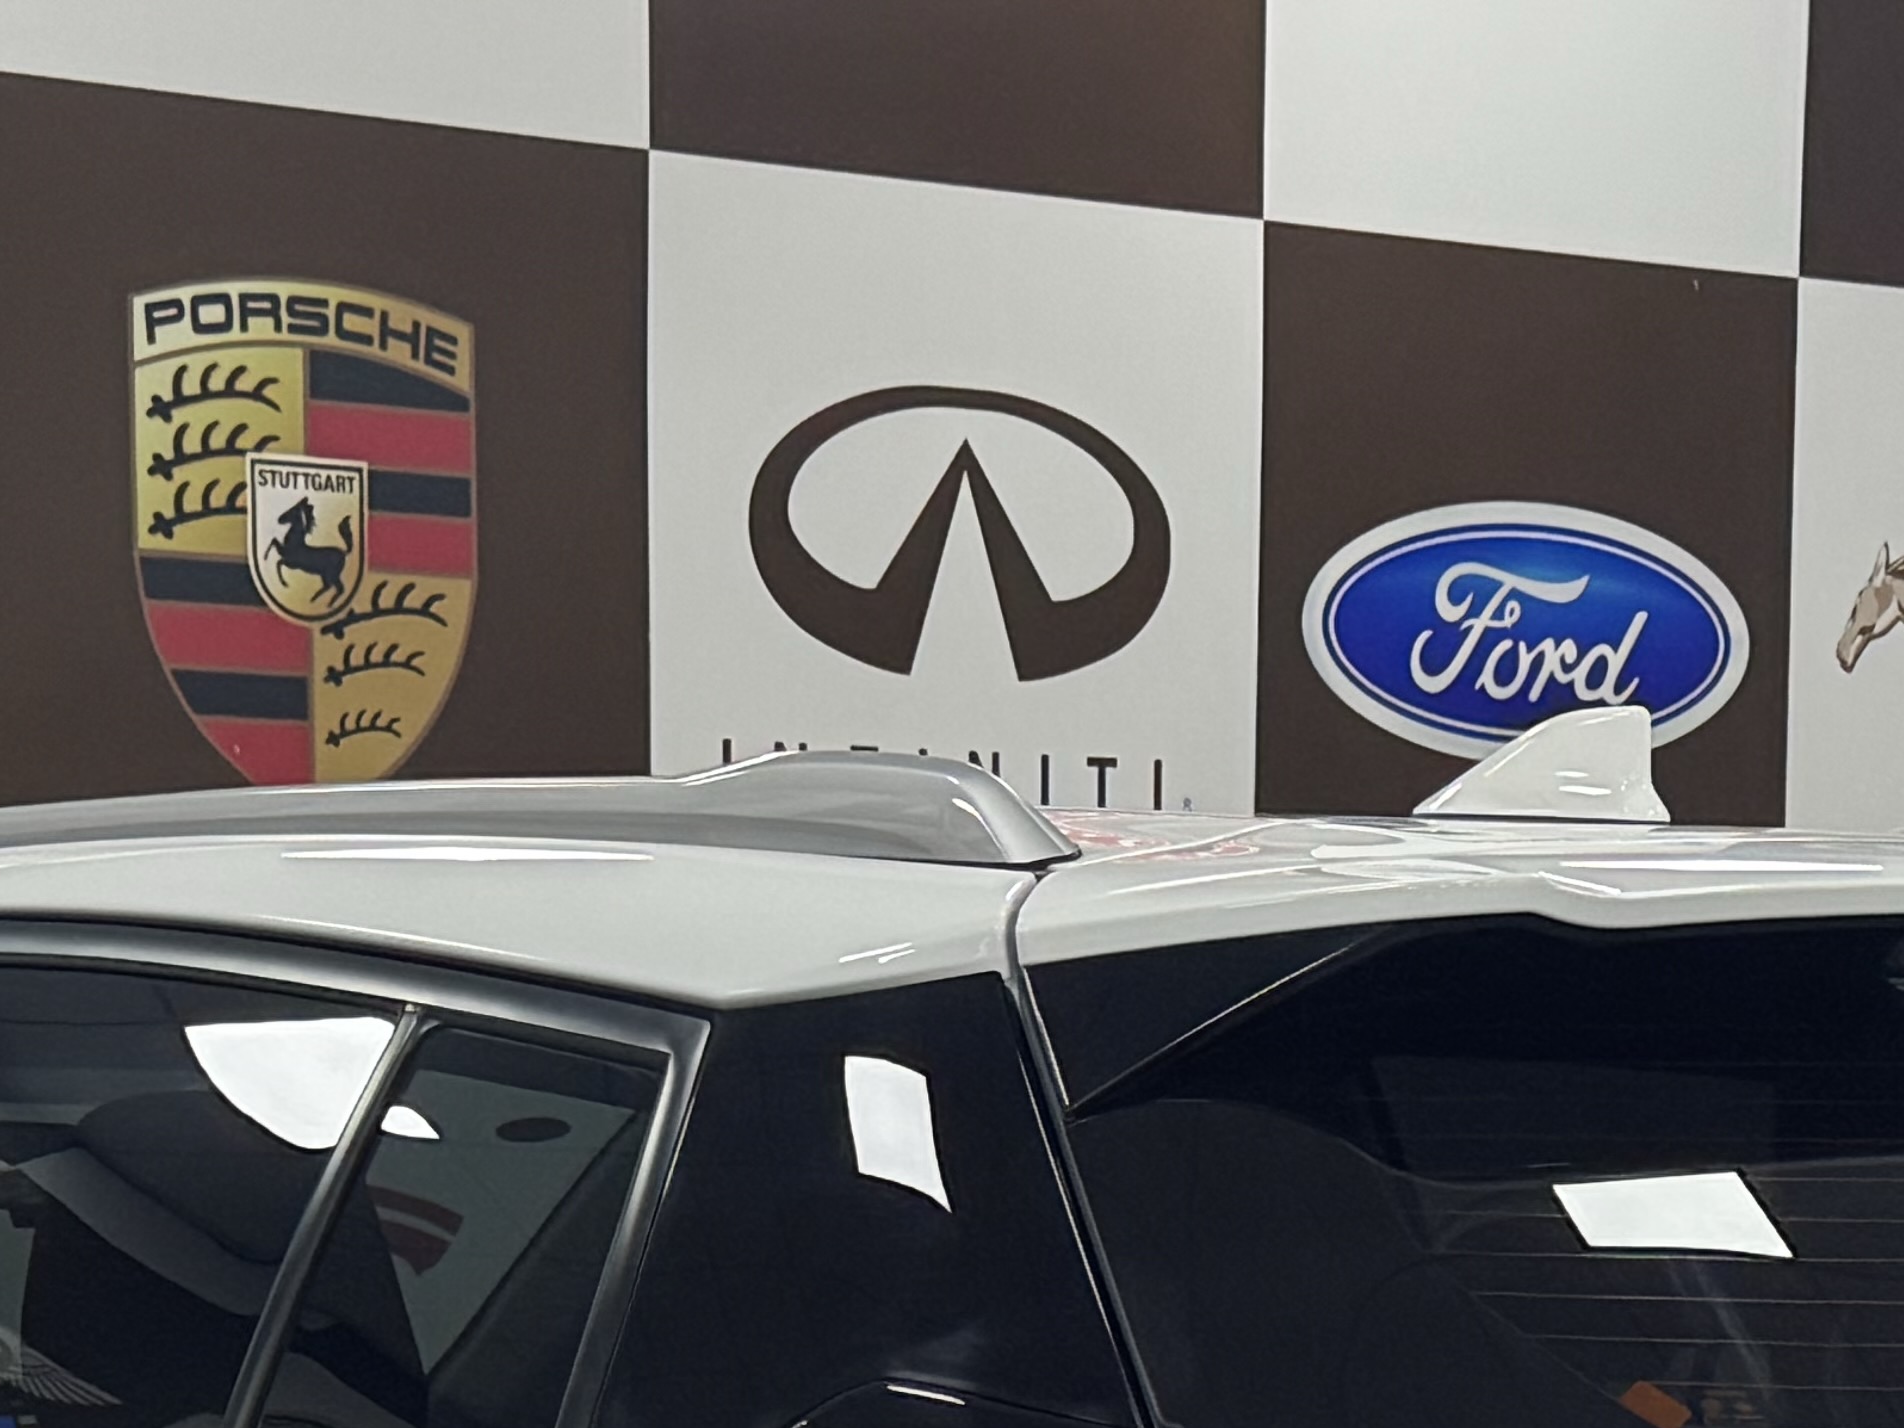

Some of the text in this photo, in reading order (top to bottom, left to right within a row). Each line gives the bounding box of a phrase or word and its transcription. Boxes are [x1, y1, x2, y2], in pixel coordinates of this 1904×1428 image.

[146, 292, 459, 376] PORSCHE
[257, 470, 357, 495] STUTTGART
[1410, 561, 1648, 706] Ford
